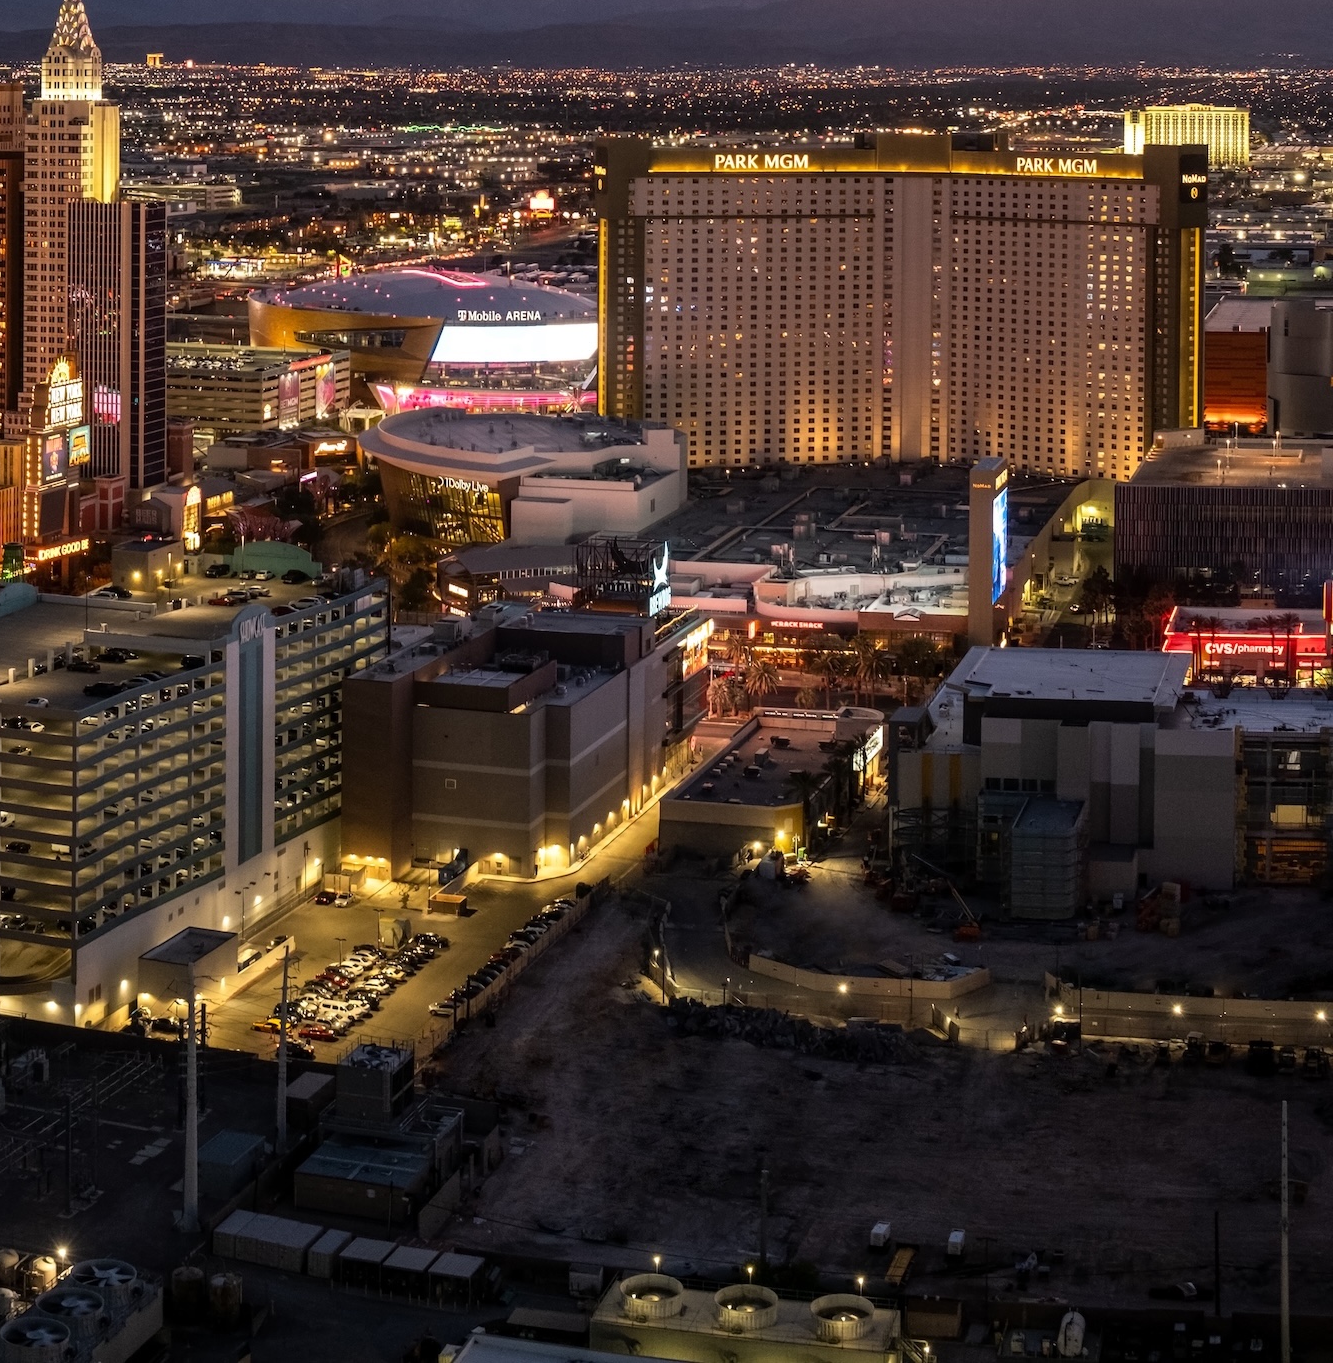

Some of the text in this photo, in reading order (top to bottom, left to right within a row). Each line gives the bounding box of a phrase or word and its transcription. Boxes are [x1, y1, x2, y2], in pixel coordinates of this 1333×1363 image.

[715, 154, 809, 169] PARK MGM
[1016, 157, 1097, 174] PARK MGM
[506, 311, 541, 321] ARENA
[448, 477, 489, 493] Dolby Live
[62, 541, 81, 555] GOOD
